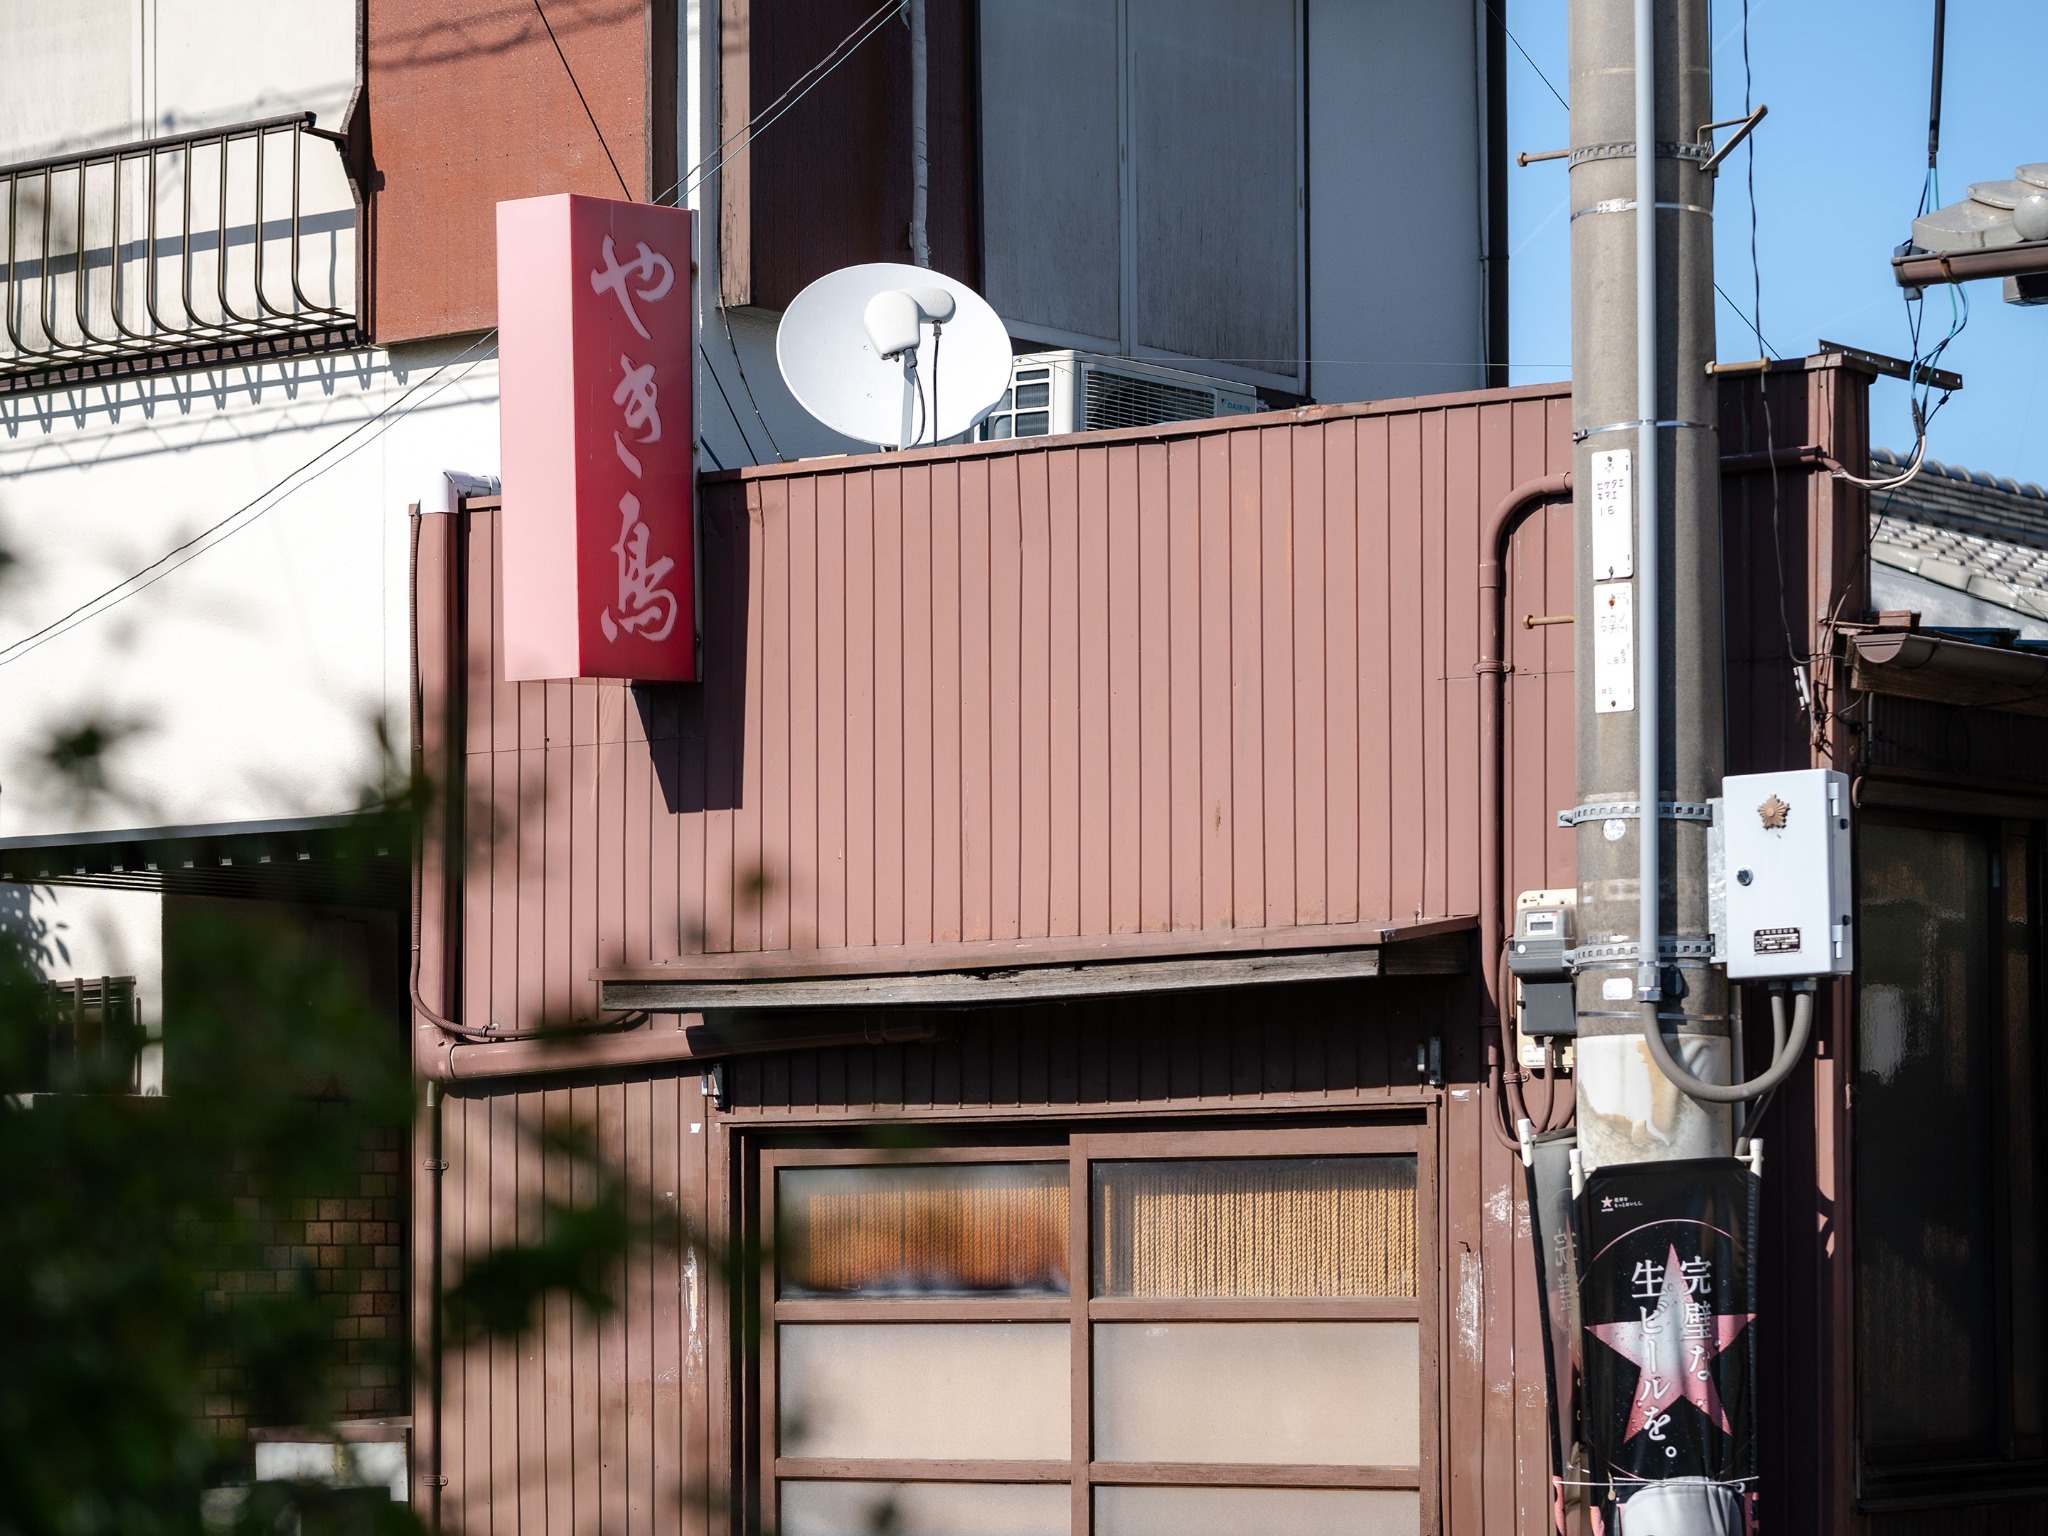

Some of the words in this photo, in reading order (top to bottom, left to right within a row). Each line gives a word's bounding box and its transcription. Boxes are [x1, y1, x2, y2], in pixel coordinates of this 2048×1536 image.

[591, 234, 678, 644] やき鳥
[1227, 402, 1251, 413] DAIKIN
[1631, 1259, 1678, 1458] 生ビールを。
[1680, 1255, 1712, 1381] 完璧な
